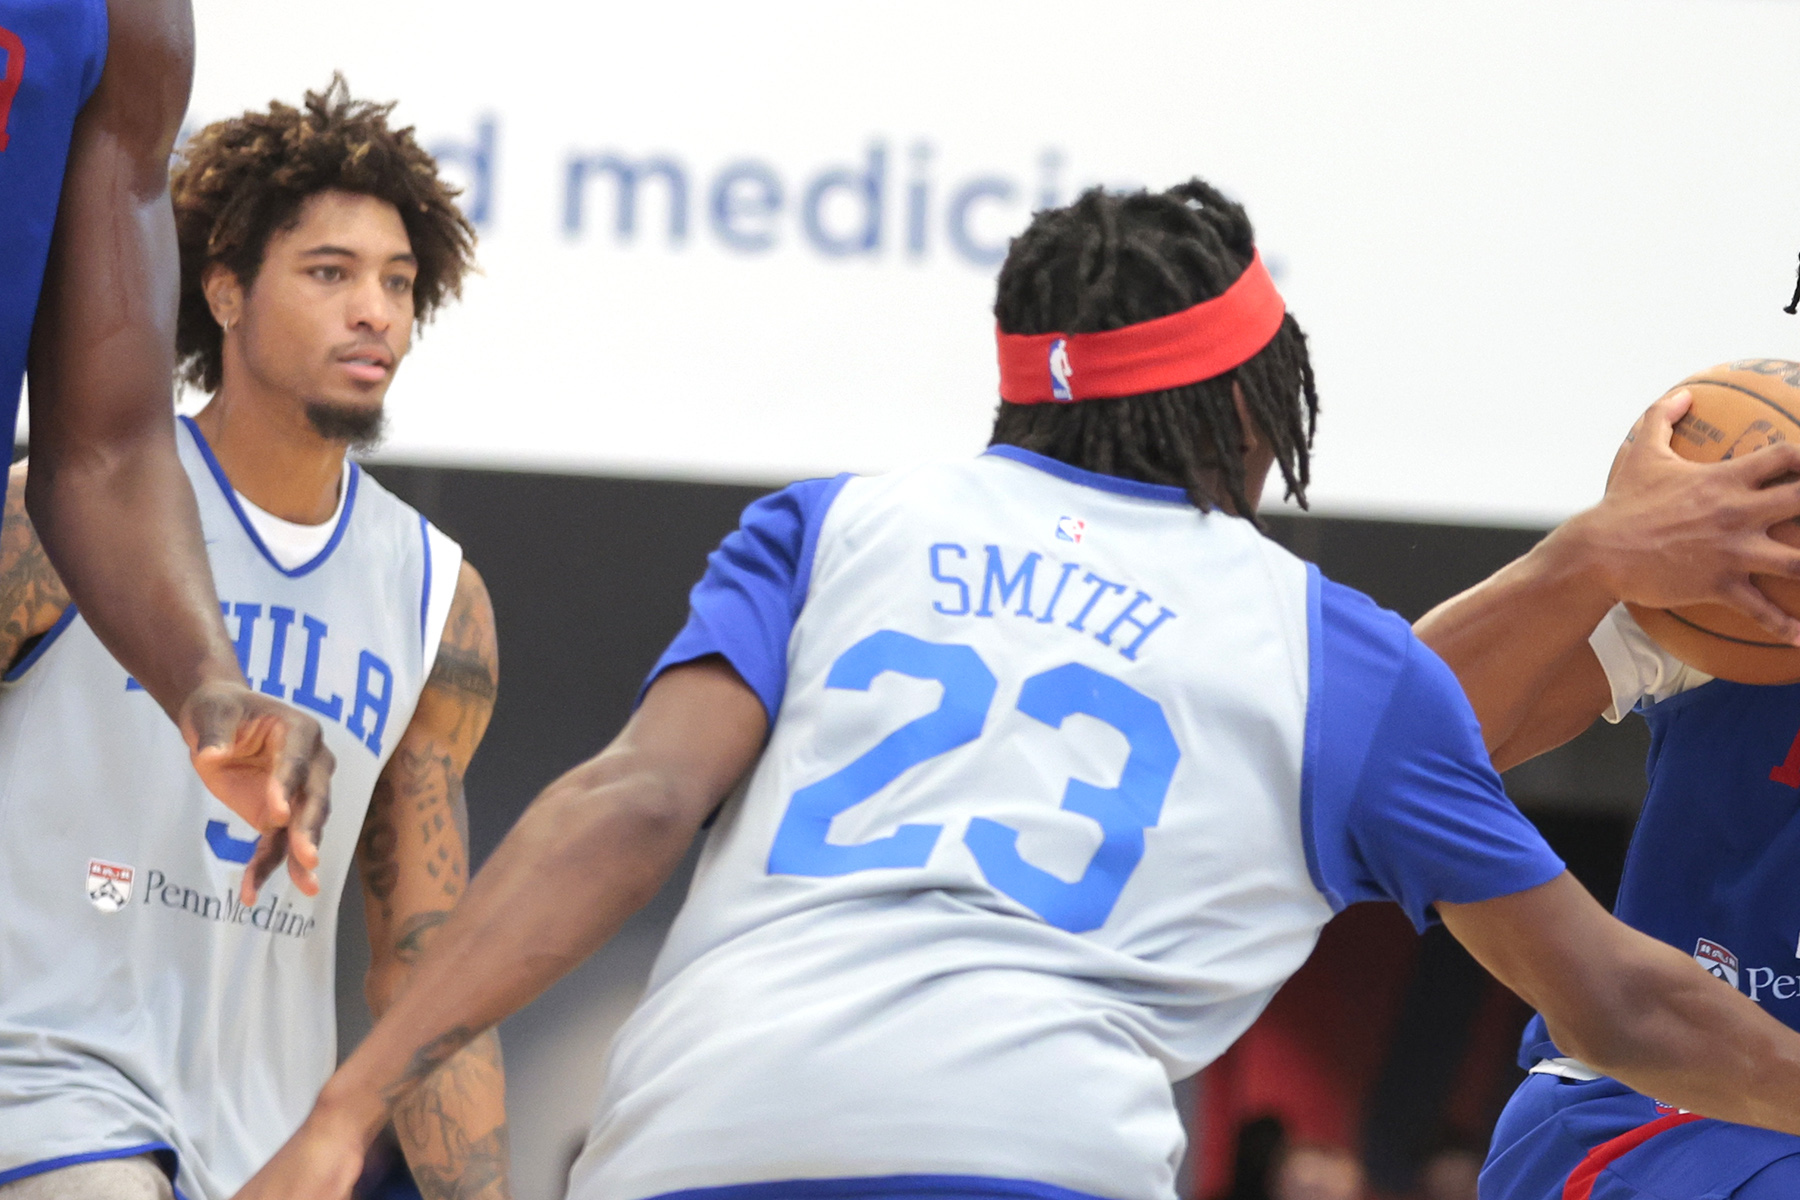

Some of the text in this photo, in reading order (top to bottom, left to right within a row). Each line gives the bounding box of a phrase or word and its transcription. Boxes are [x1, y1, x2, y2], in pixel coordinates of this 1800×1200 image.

[560, 134, 1286, 278] medici
[928, 542, 1177, 660] SMITH
[127, 602, 393, 757] HILA
[767, 628, 1182, 933] 23
[144, 869, 222, 920] Penn
